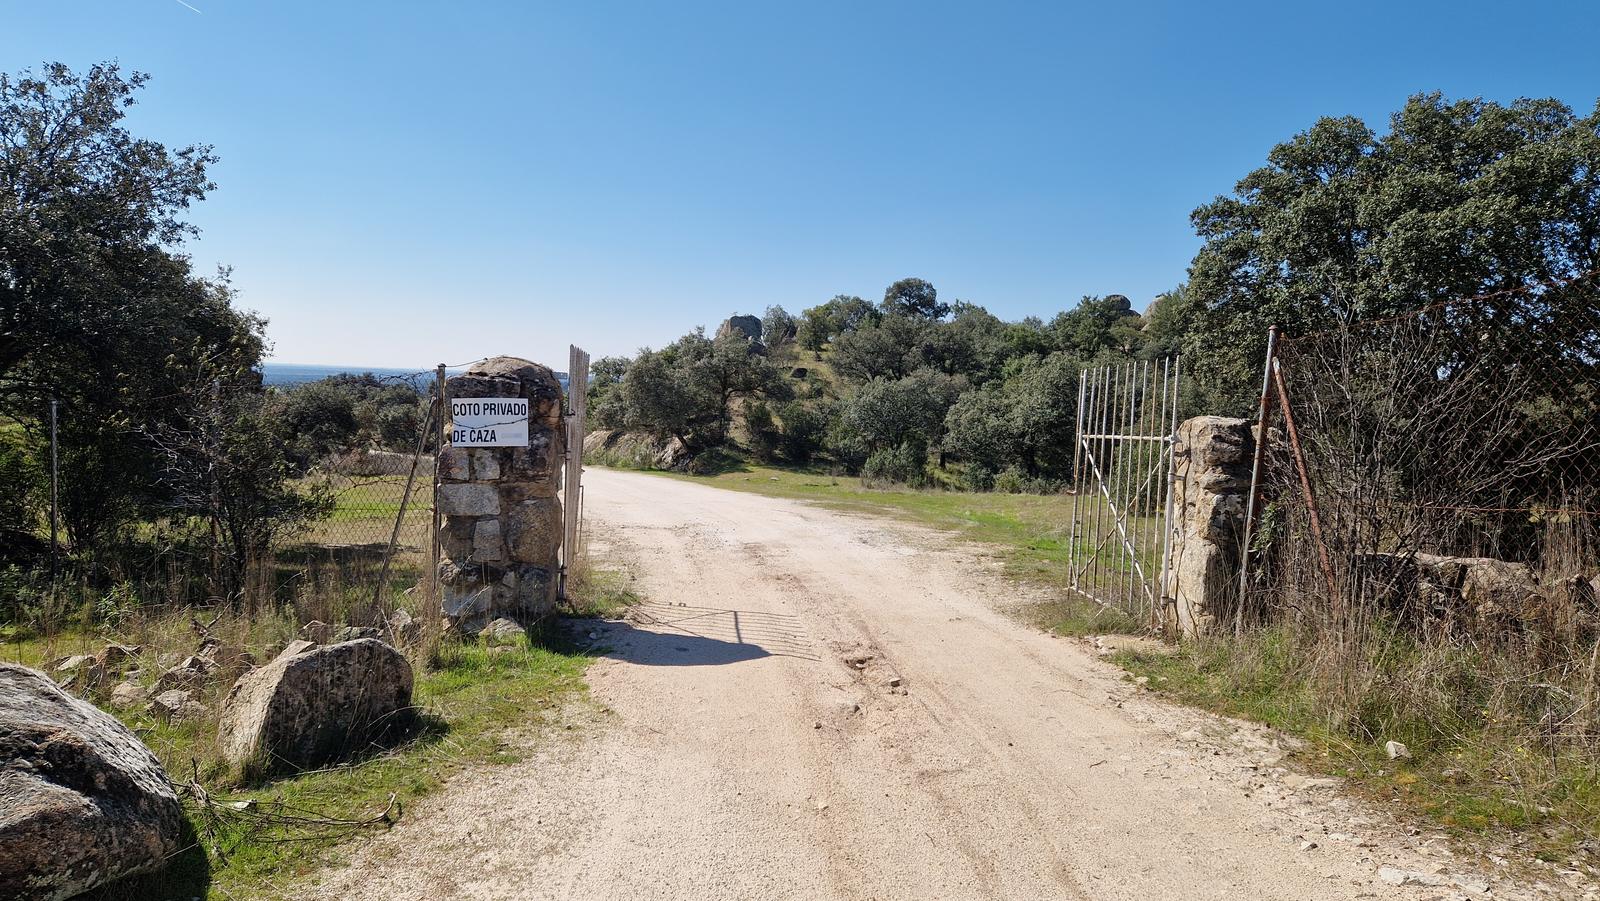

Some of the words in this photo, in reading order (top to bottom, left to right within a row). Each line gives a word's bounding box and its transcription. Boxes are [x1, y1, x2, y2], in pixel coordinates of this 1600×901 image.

[453, 403, 480, 416] COTO
[483, 403, 527, 416] PRIVADO
[453, 430, 466, 442] DE
[469, 430, 497, 442] CAZA
